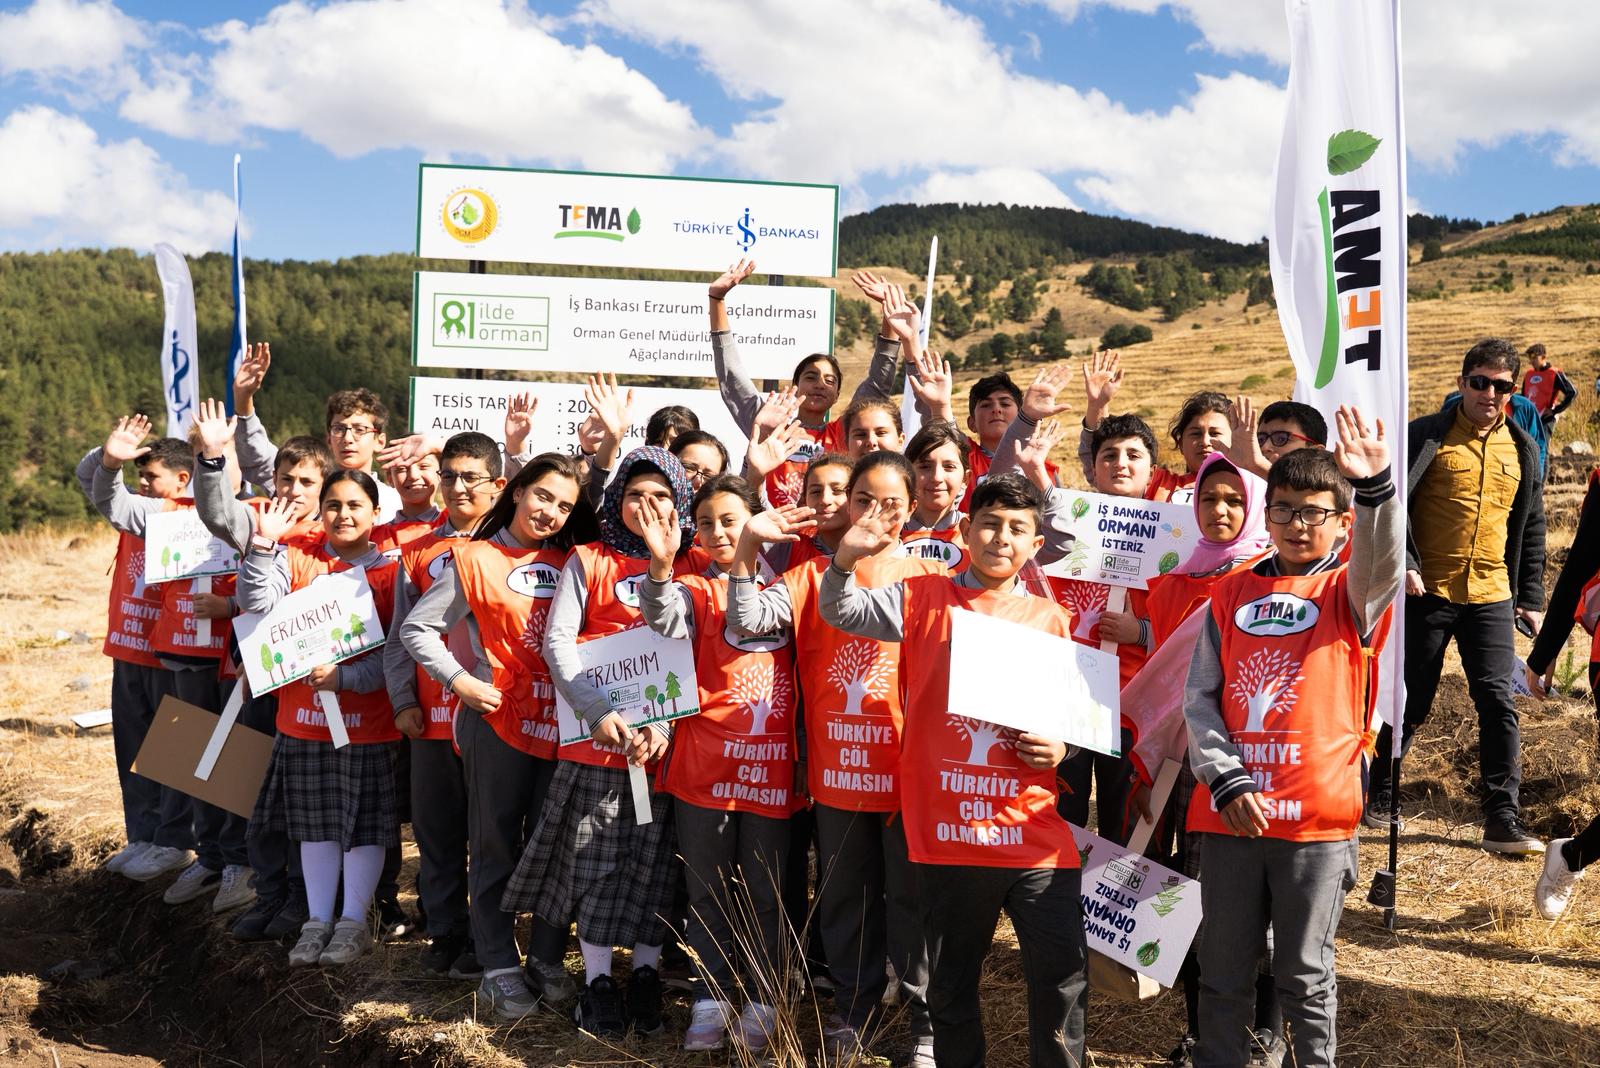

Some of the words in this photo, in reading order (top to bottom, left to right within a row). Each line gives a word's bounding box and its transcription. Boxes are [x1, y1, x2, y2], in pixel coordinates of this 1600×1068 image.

[558, 204, 622, 230] TEMA
[673, 220, 734, 235] TÜRKİYE
[759, 227, 819, 240] BANKASI
[479, 302, 515, 320] ilde
[569, 294, 580, 312] İş
[585, 298, 639, 312] Bankası
[644, 300, 703, 315] Erzurum
[708, 304, 817, 319] açlandırması
[479, 327, 542, 342] orman
[573, 326, 615, 339] Orman
[619, 328, 655, 341] Genel
[658, 329, 712, 343] Müdürlü
[629, 348, 713, 363] Ağaçlandırılm
[433, 392, 473, 409] TESİS
[432, 417, 479, 431] ALANI
[1098, 502, 1109, 518] İŞ
[1113, 506, 1161, 522] BANKASI
[1098, 519, 1157, 539] ORMANI
[1102, 536, 1146, 554] İSTERİZ.
[1254, 601, 1294, 620] TEMA
[124, 617, 144, 635] ÇÖL
[270, 600, 342, 645] ERZURUM
[110, 631, 152, 652] OLMASI
[586, 651, 660, 689] ERZURUM
[827, 718, 892, 744] TÜRKİYE
[723, 739, 788, 761] TÜRKİYE
[839, 744, 870, 770] ÇÖL
[737, 762, 769, 784] ÇÖL
[823, 768, 893, 793] OLMASIN
[940, 768, 1019, 798] TÜRKİYE
[1251, 766, 1274, 792] ÖL
[712, 782, 787, 806] OLMASIN
[959, 797, 996, 824] ÇÖL
[937, 822, 1023, 846] OLMASIN
[1095, 880, 1138, 914] İSTERİZ.
[1118, 934, 1132, 954] İŞ
